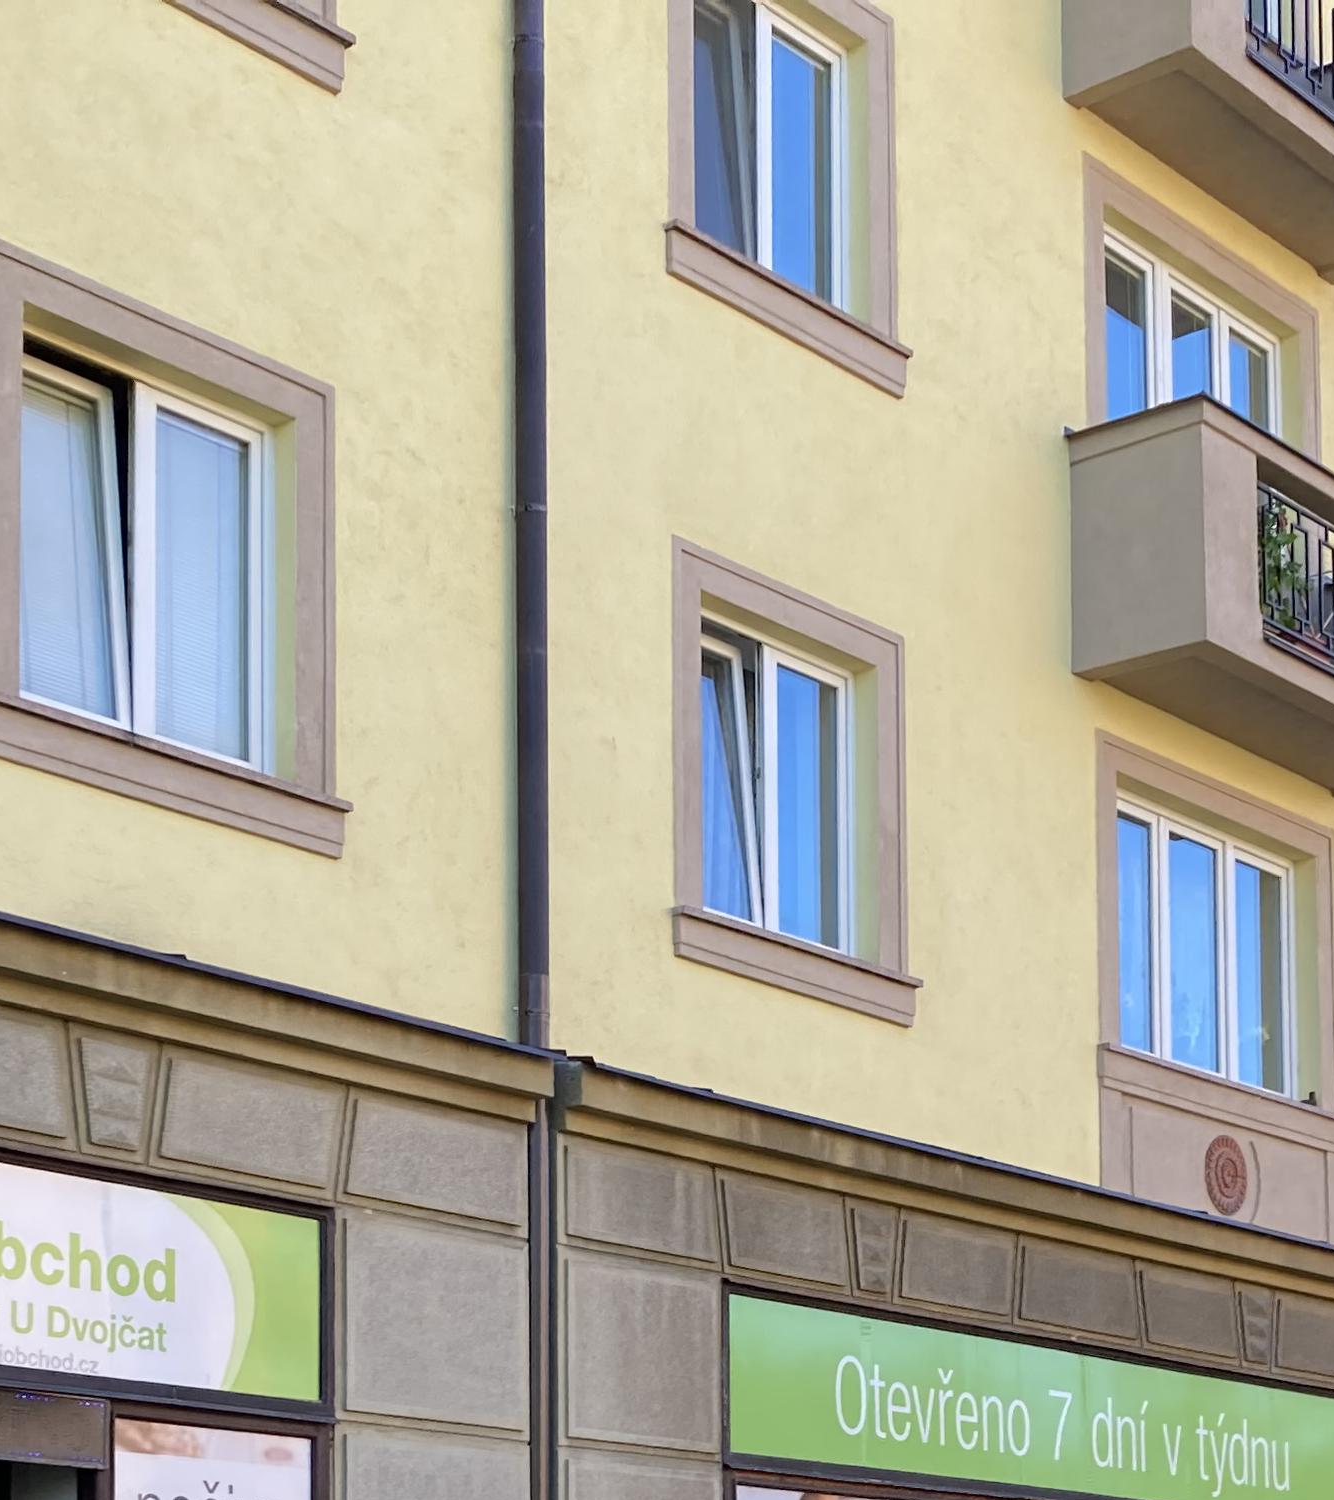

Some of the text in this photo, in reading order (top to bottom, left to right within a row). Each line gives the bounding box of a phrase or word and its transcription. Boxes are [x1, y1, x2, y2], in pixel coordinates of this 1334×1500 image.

[11, 1300, 34, 1334] U
[47, 1305, 167, 1353] Dvojčat
[835, 1355, 1290, 1497] Otevřeno 7 dní v týdnu
